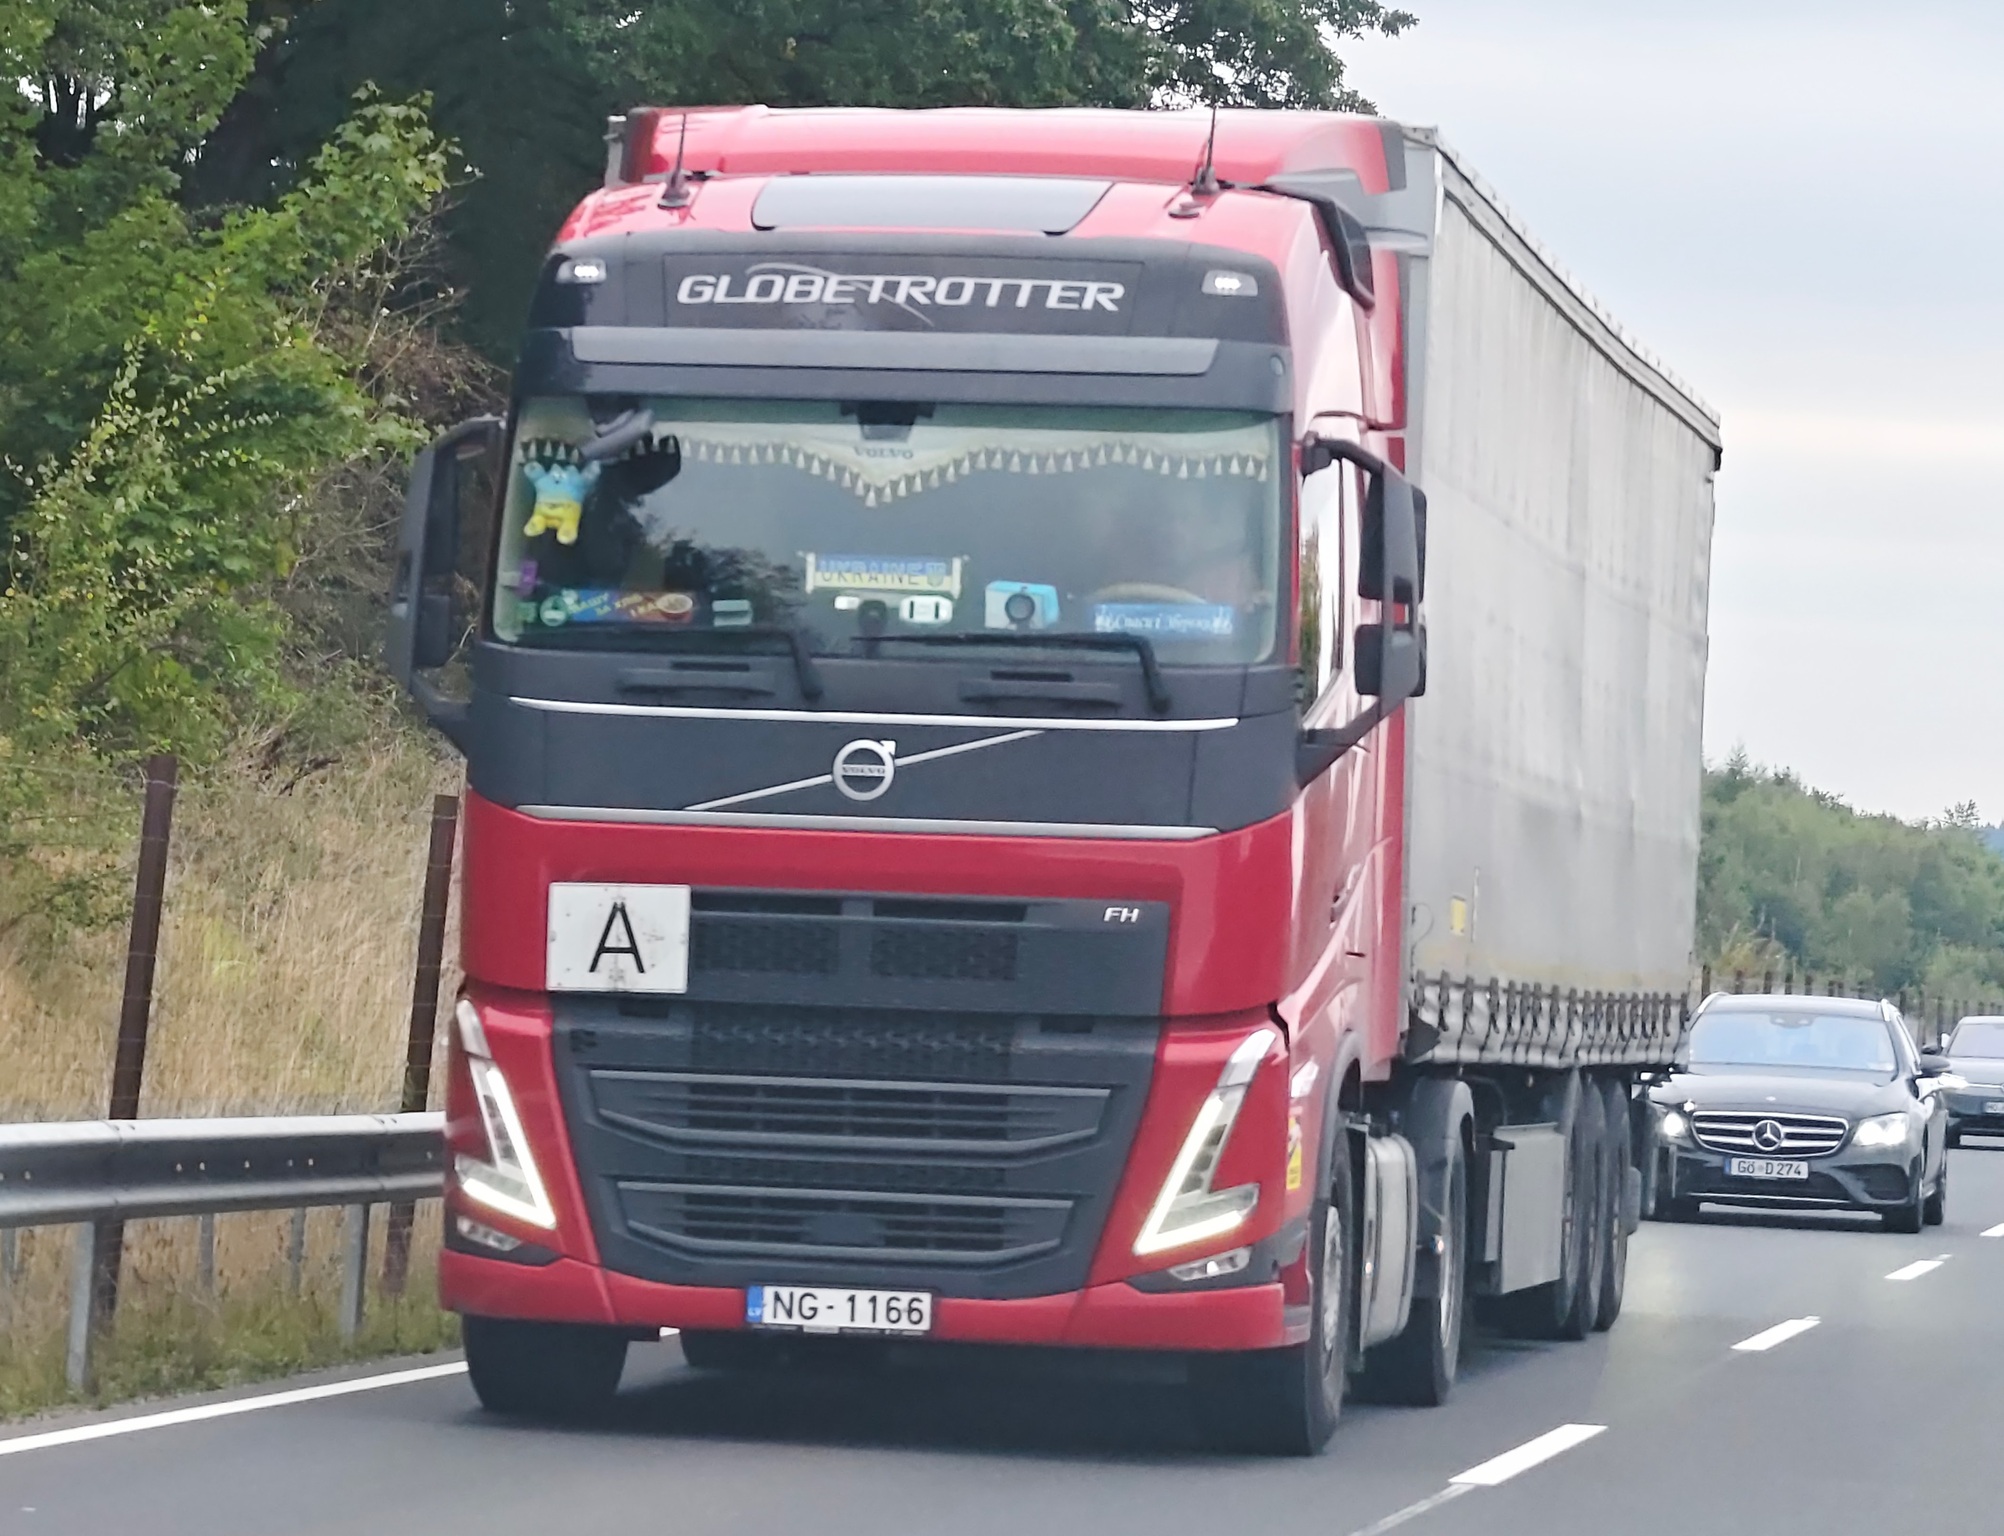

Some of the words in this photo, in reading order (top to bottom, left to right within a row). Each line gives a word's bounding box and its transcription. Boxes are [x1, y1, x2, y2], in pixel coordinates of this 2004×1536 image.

[677, 274, 1126, 312] GLOBETROTTER
[853, 445, 914, 460] VOLVO
[820, 561, 922, 587] UKRAINE
[1103, 907, 1140, 923] FH
[588, 901, 645, 974] A
[1738, 1160, 1755, 1174] GÖ
[1765, 1162, 1774, 1175] D
[1776, 1162, 1802, 1176] 274
[773, 1290, 924, 1326] NG-1166
